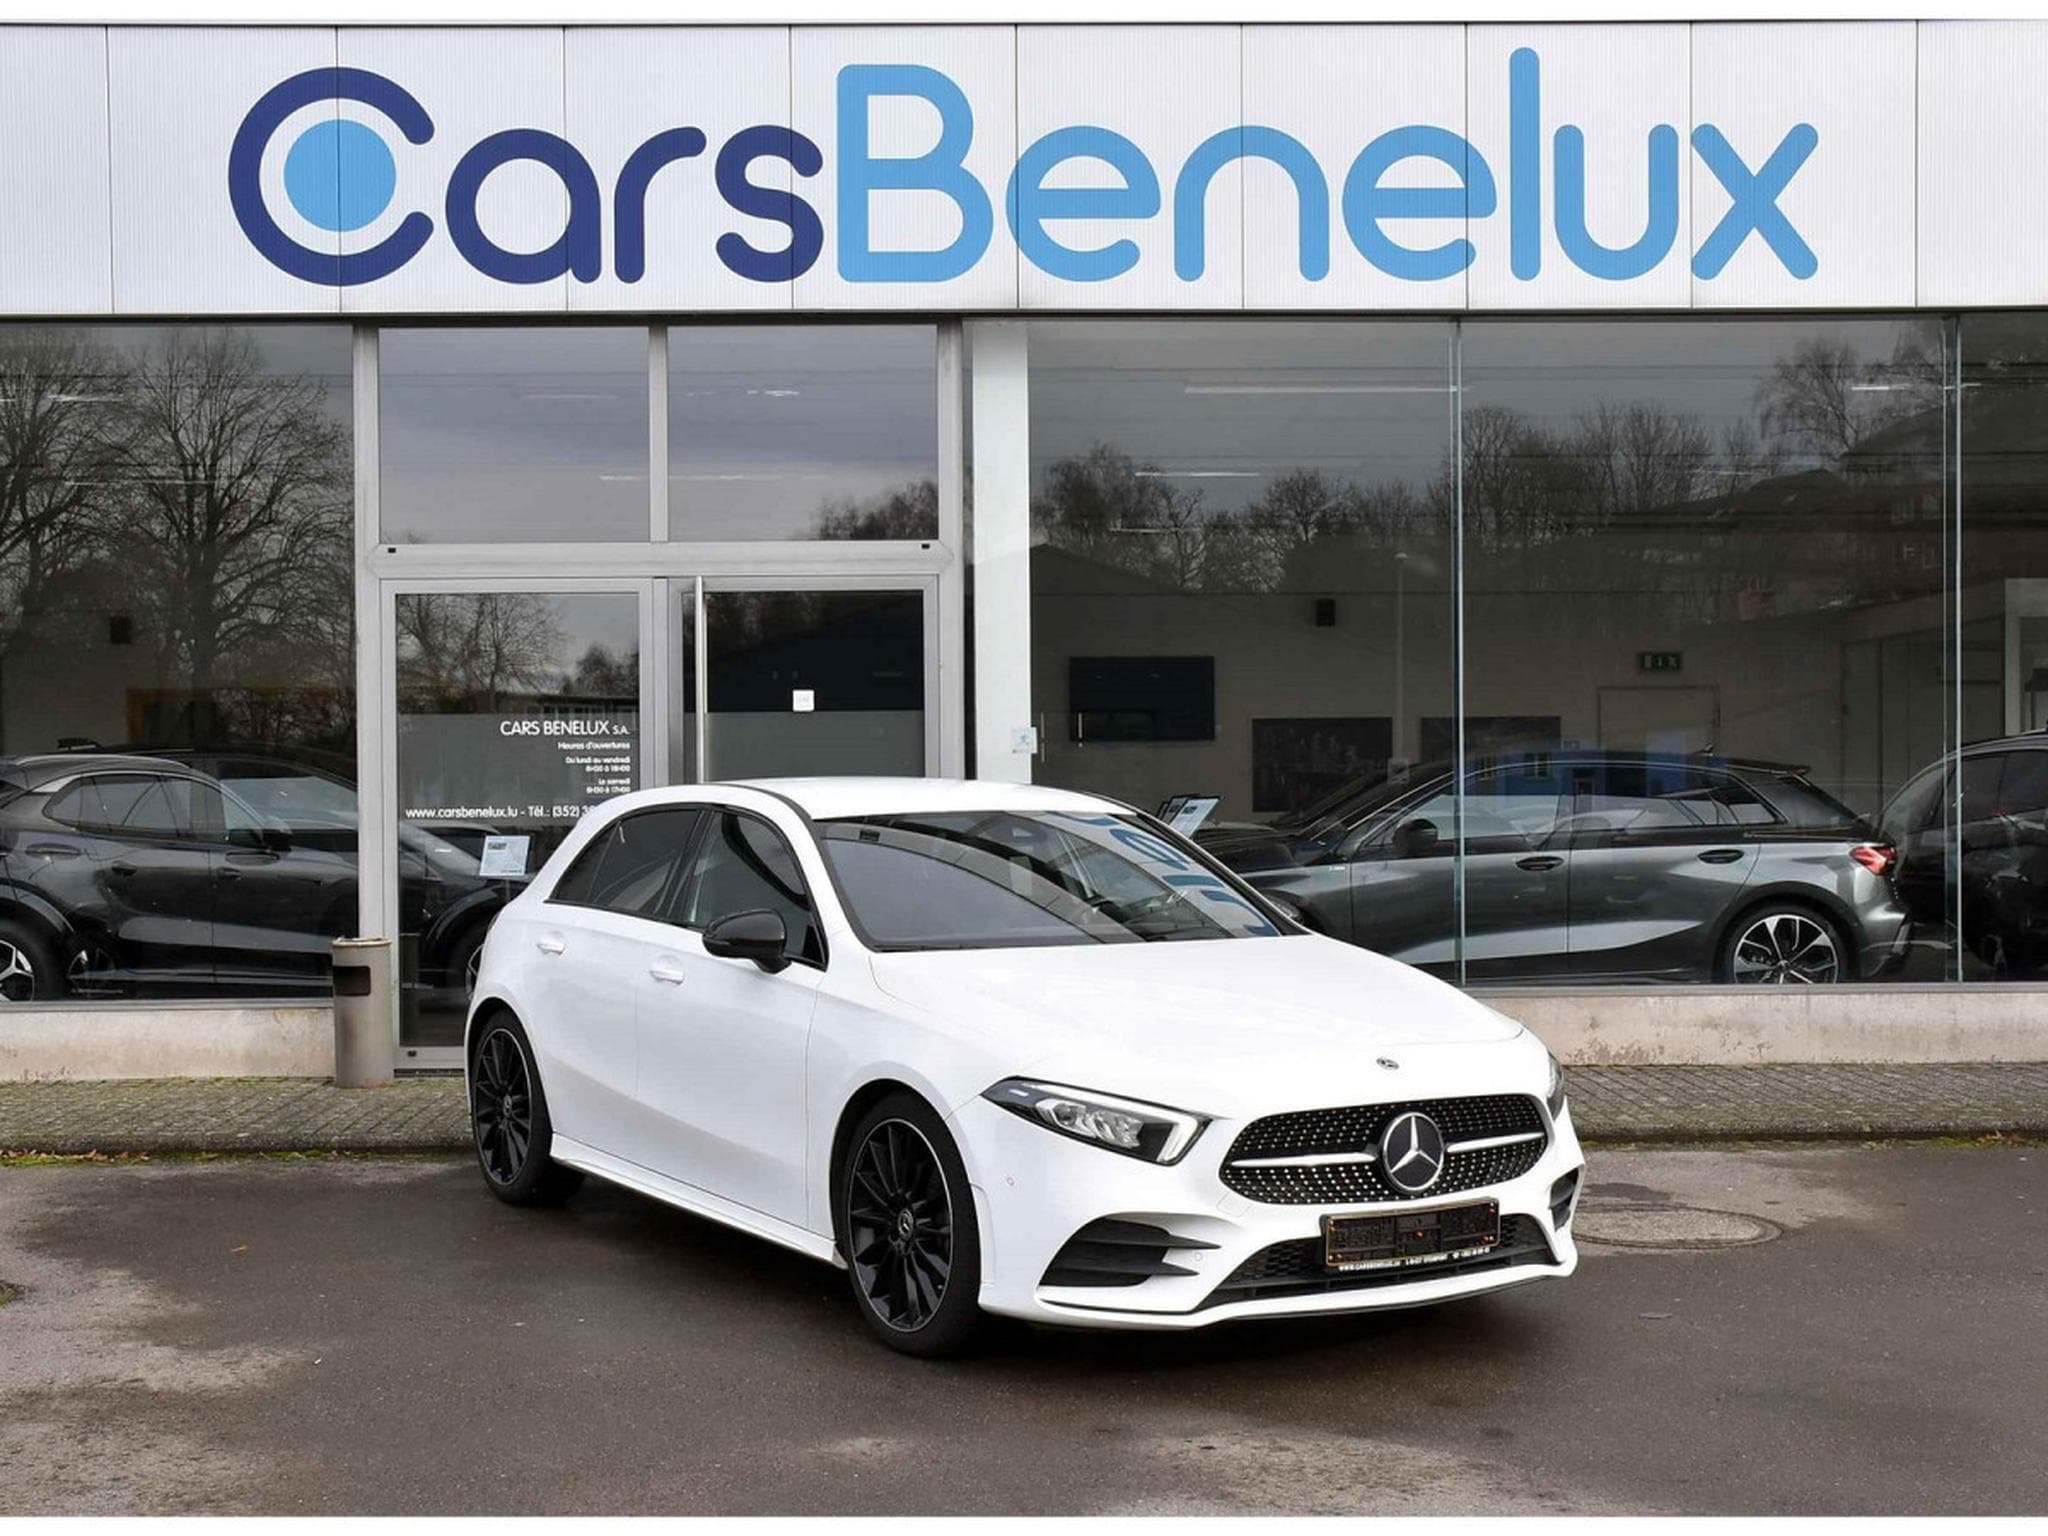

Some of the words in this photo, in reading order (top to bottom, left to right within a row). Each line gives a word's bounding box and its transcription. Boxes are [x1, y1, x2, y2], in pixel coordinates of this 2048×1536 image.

[500, 721, 541, 735] CARS
[543, 720, 610, 735] BENELUX
[557, 742, 585, 750] Heures
[602, 756, 631, 764] vendredi
[607, 777, 631, 785] samedi
[405, 805, 518, 818] www.carsbenelux.lu
[552, 805, 580, 818] (352)
